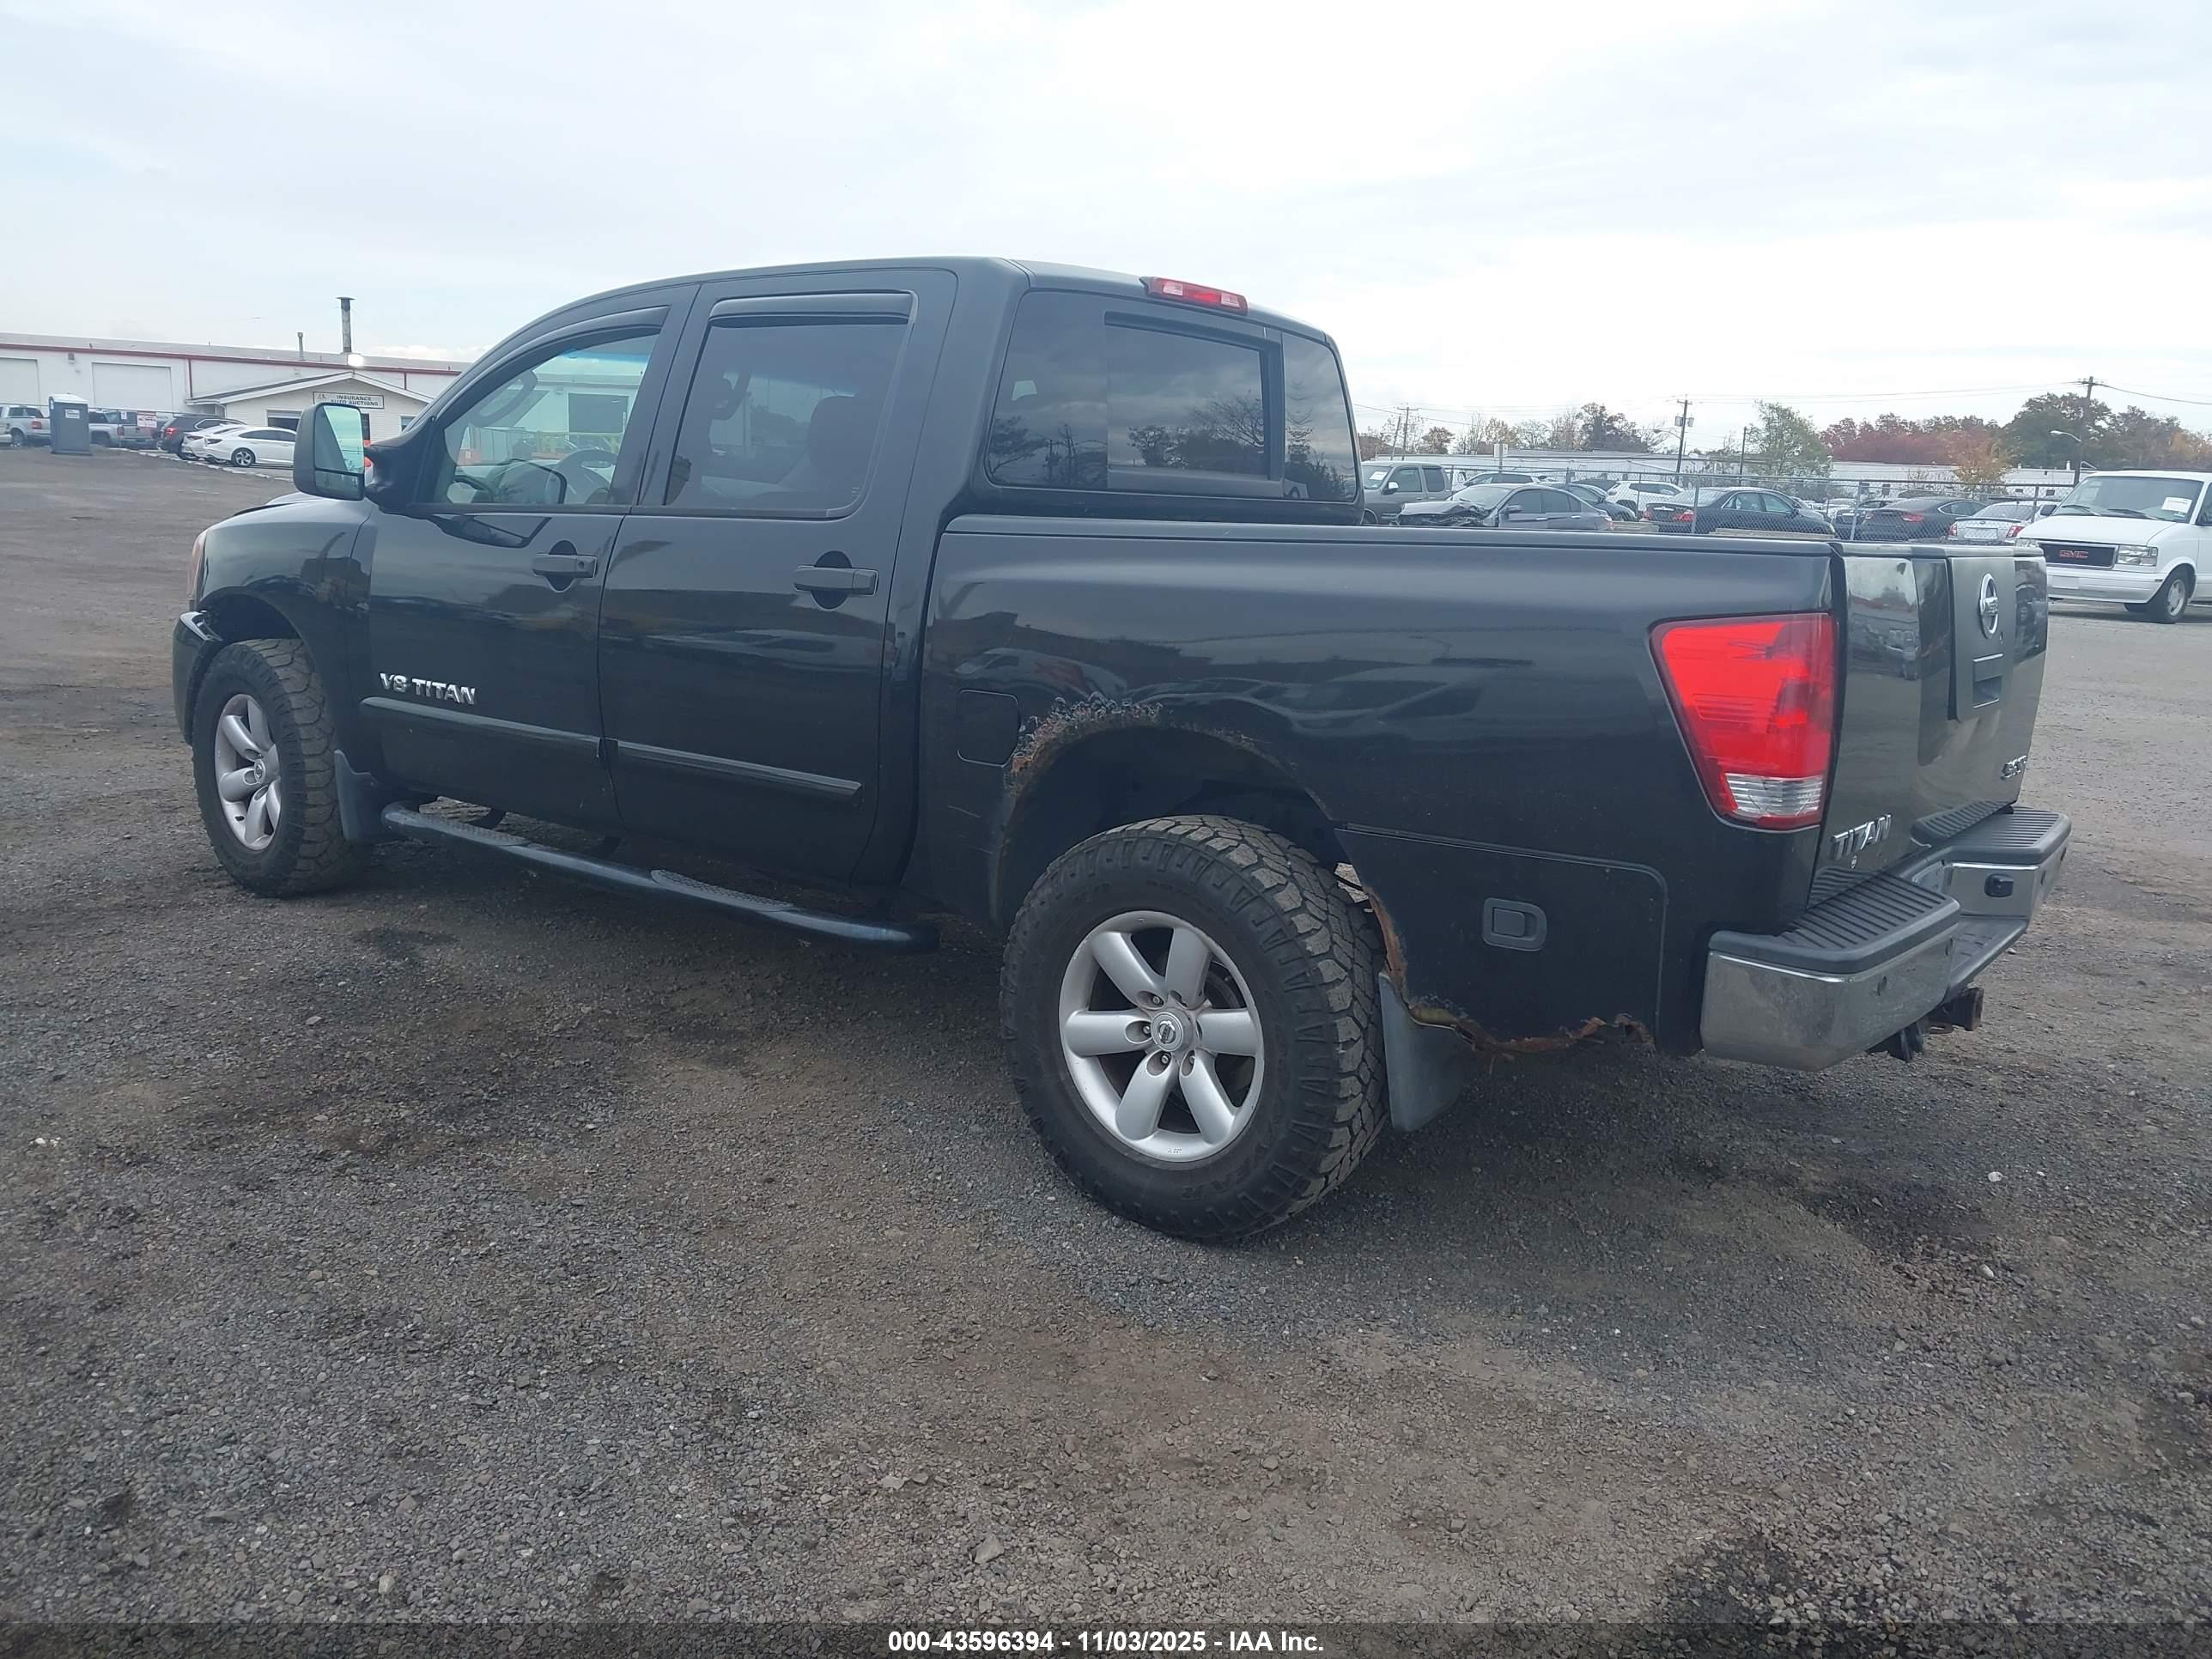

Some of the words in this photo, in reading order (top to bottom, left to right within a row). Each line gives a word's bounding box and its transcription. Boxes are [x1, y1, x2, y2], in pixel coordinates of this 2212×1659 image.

[2059, 550, 2089, 559] GMC
[380, 672, 408, 693] V8
[411, 678, 476, 705] TITAN
[1832, 814, 1892, 860] TITAN
